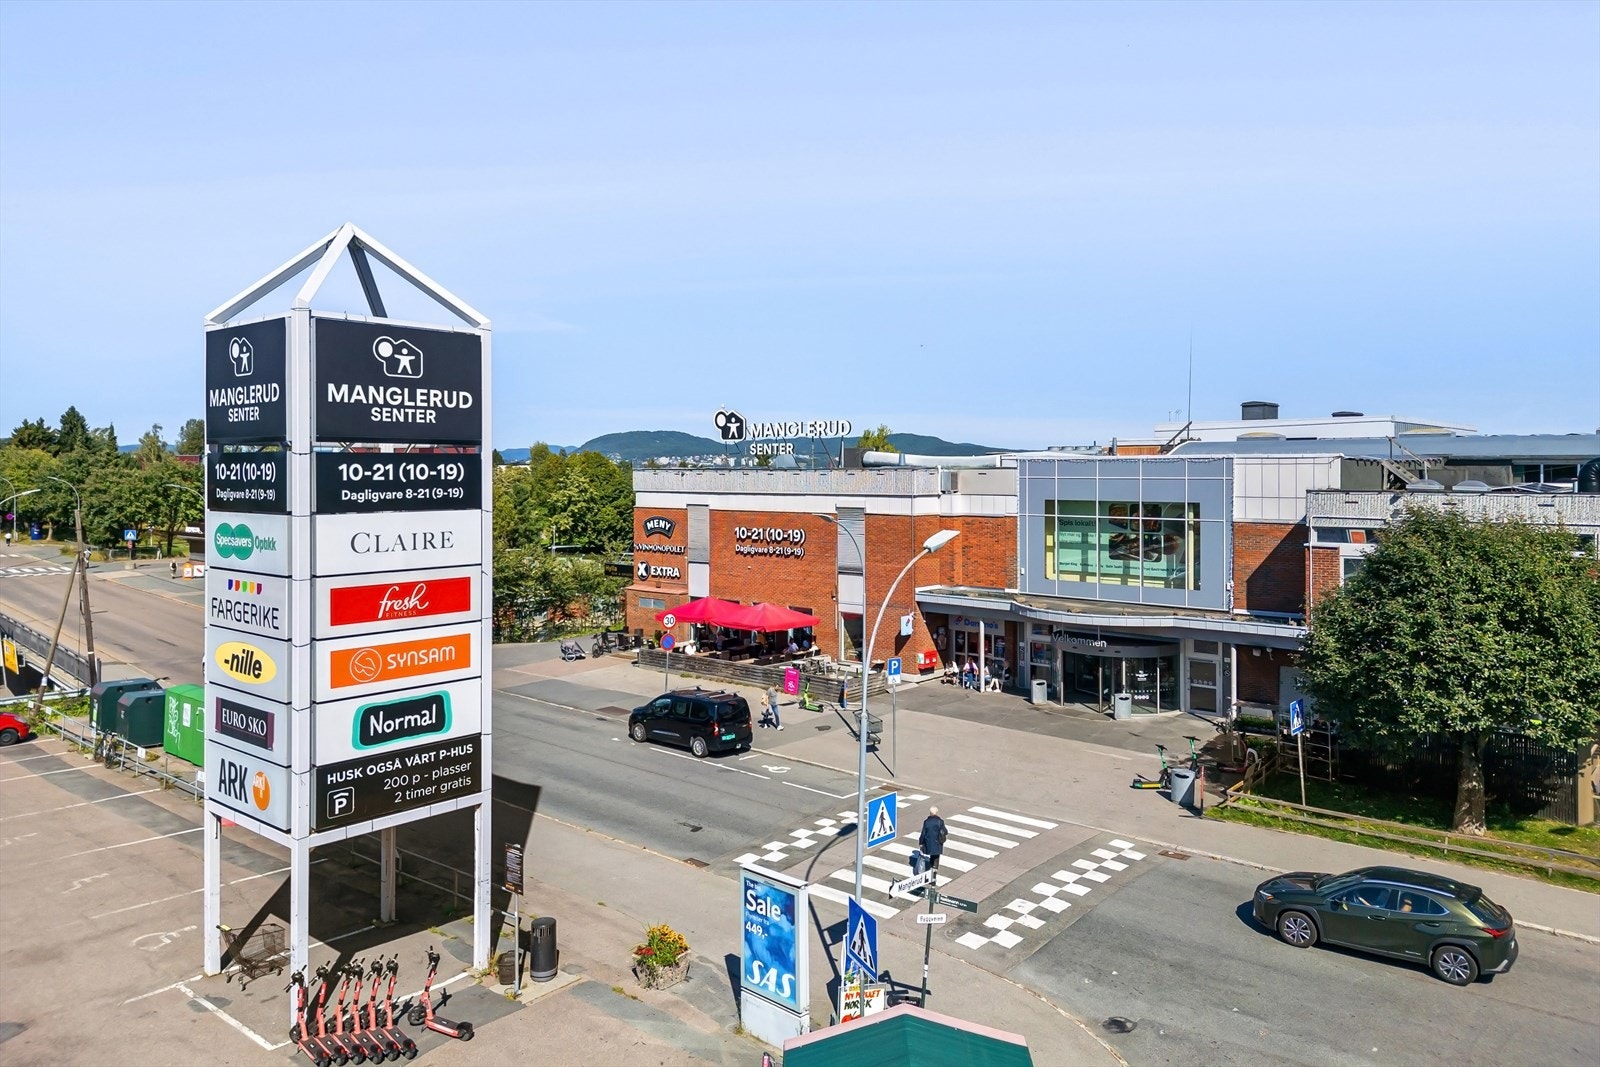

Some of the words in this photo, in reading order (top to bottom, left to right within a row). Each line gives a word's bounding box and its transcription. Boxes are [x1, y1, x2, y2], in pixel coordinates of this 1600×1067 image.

[209, 382, 280, 407] MANGLERUD
[327, 382, 473, 409] MANGLERUD
[228, 406, 260, 422] SENTER
[370, 406, 437, 424] SENTER
[750, 420, 852, 438] MANGLERUD
[749, 442, 795, 455] SENTER
[215, 463, 241, 481] 10-21
[242, 461, 276, 483] (10-19)
[338, 463, 394, 481] 10-21
[399, 462, 465, 483] (10-19)
[216, 488, 244, 501] Dagligvare
[245, 489, 258, 499] 8-21
[258, 488, 276, 501] (9-19)
[341, 489, 403, 504] Dagligvare
[405, 488, 430, 499] 8-21
[432, 487, 464, 500] (9-19)
[646, 519, 671, 530] MENY
[216, 532, 252, 547] Specsavers
[254, 535, 277, 553] Optikk
[350, 530, 455, 554] CLAIRE
[734, 526, 764, 540] 10-21
[766, 527, 806, 544] (10-19)
[638, 543, 686, 553] VINMONOPOLET
[735, 544, 768, 555] Dagligvare
[768, 546, 783, 555] 8-21
[784, 546, 804, 557] (9-19)
[650, 565, 681, 578] EXTRA
[378, 583, 429, 619] fresh
[211, 596, 280, 630] FARGERIKE
[385, 610, 417, 618] FITNESS
[664, 616, 675, 625] 30
[1052, 632, 1107, 648] Velkommen
[223, 648, 263, 679] -nille
[387, 645, 456, 670] SYNSAM
[891, 660, 899, 674] P
[222, 707, 247, 730] EURO
[247, 716, 267, 736] SKO
[370, 703, 436, 737] Normal
[327, 767, 363, 785] HUSK
[366, 757, 402, 776] OGSÅ
[405, 753, 437, 767] VÅRT
[439, 743, 474, 760] P-HUS
[218, 757, 249, 804] ARK
[383, 774, 409, 791] 200
[412, 773, 421, 785] p
[432, 761, 472, 781] plasser
[394, 791, 402, 803] 2
[406, 784, 437, 800] timer
[440, 776, 472, 794] gratis
[334, 797, 348, 815] P
[897, 876, 923, 893] Manglerud
[746, 889, 781, 922] Sale
[745, 921, 768, 940] 449,-
[746, 959, 795, 998] SAS
[844, 999, 872, 1010] NORK
